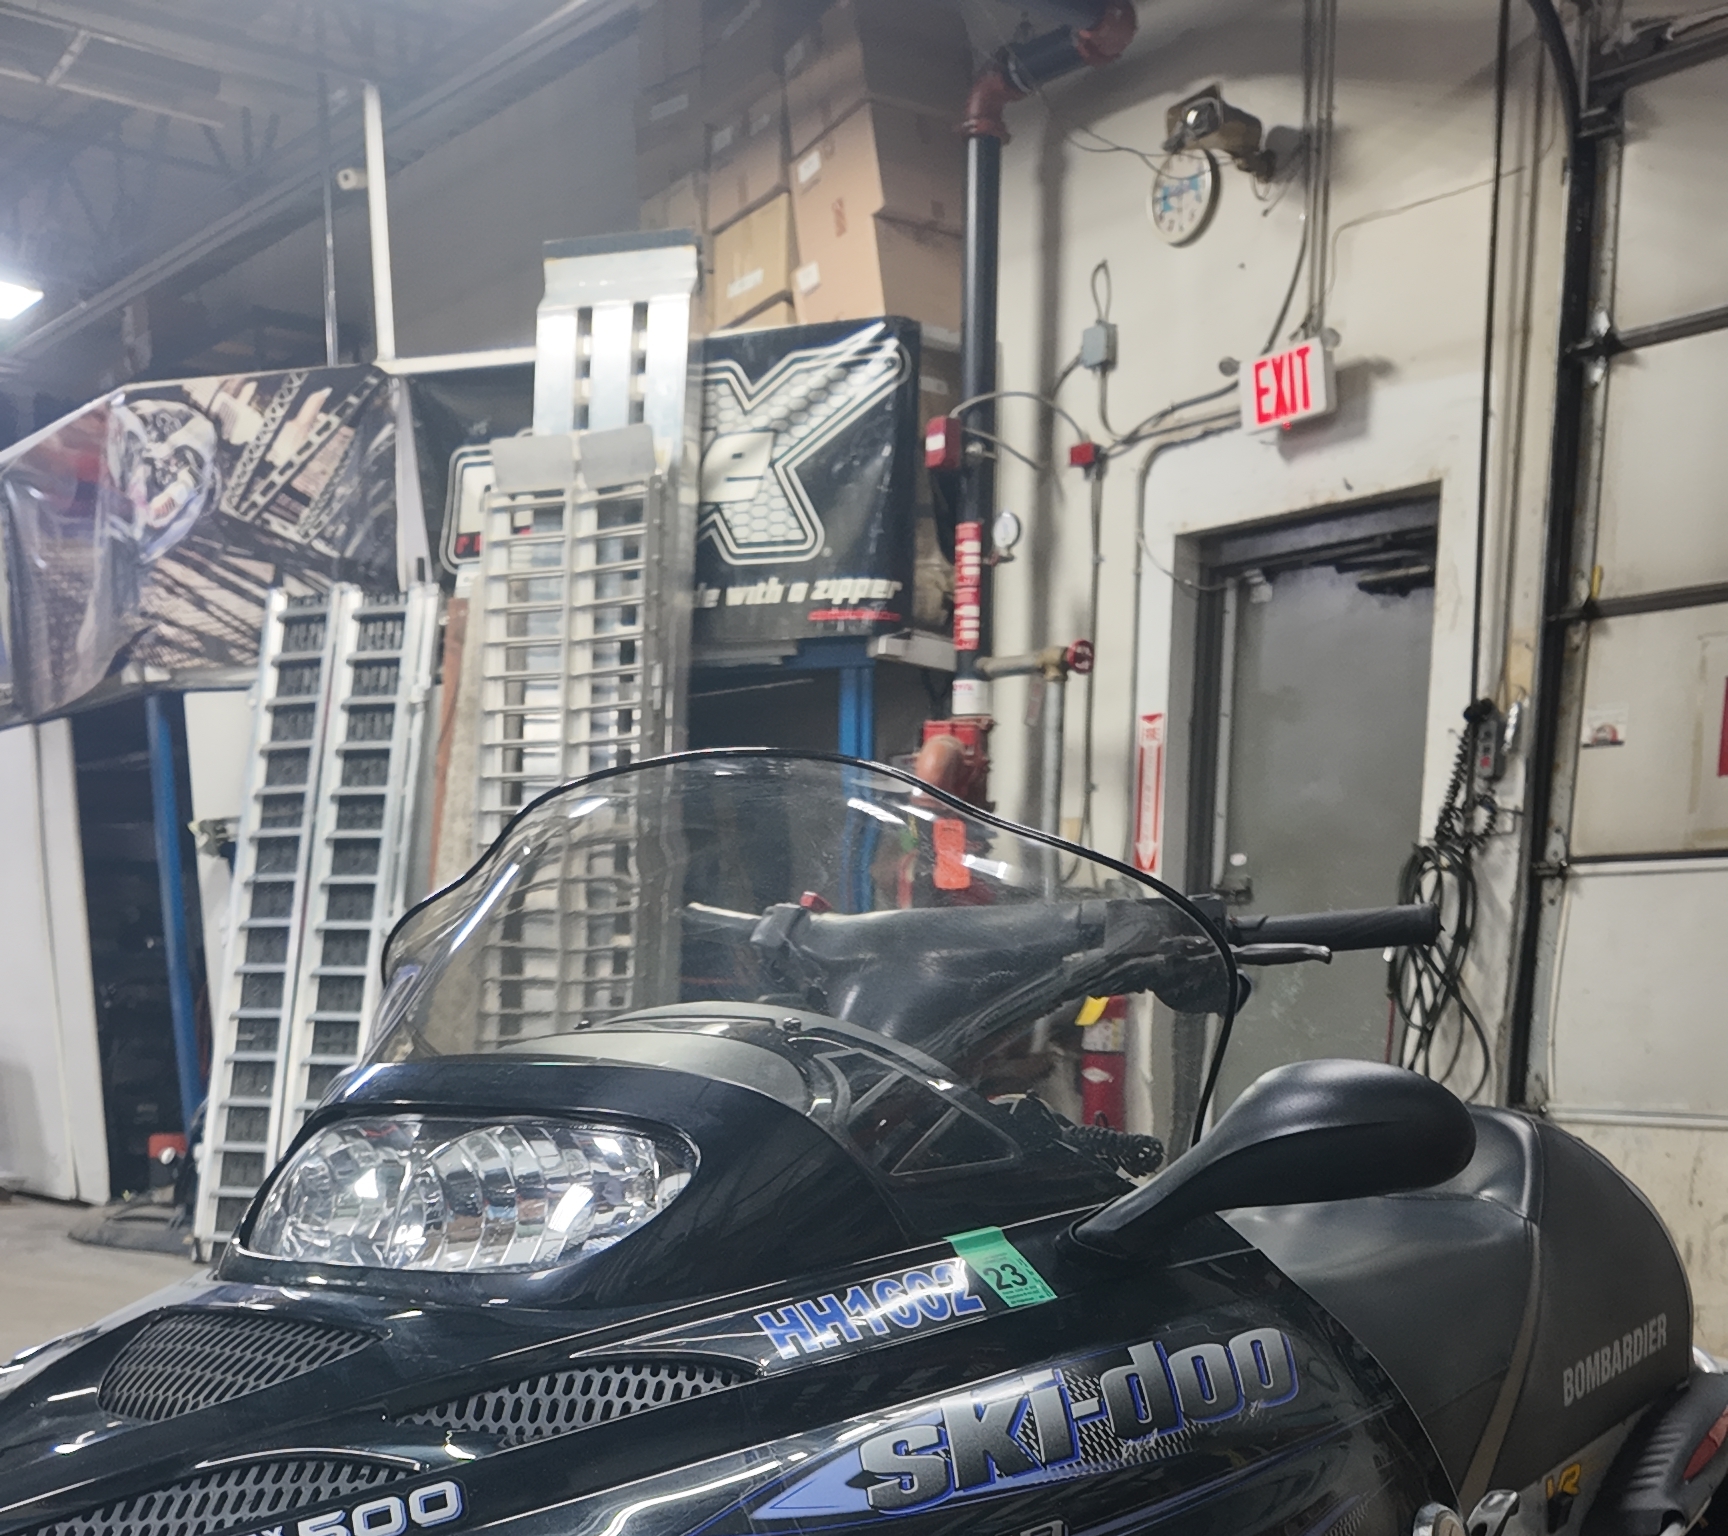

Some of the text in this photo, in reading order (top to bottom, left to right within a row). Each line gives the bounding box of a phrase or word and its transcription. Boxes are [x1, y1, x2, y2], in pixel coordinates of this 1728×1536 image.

[1253, 346, 1310, 424] EXIT
[726, 577, 784, 606] with
[810, 577, 903, 605] zipper
[754, 1263, 986, 1359] HH1602
[983, 1263, 1028, 1291] 23
[1563, 1312, 1667, 1407] BOMBARDIER
